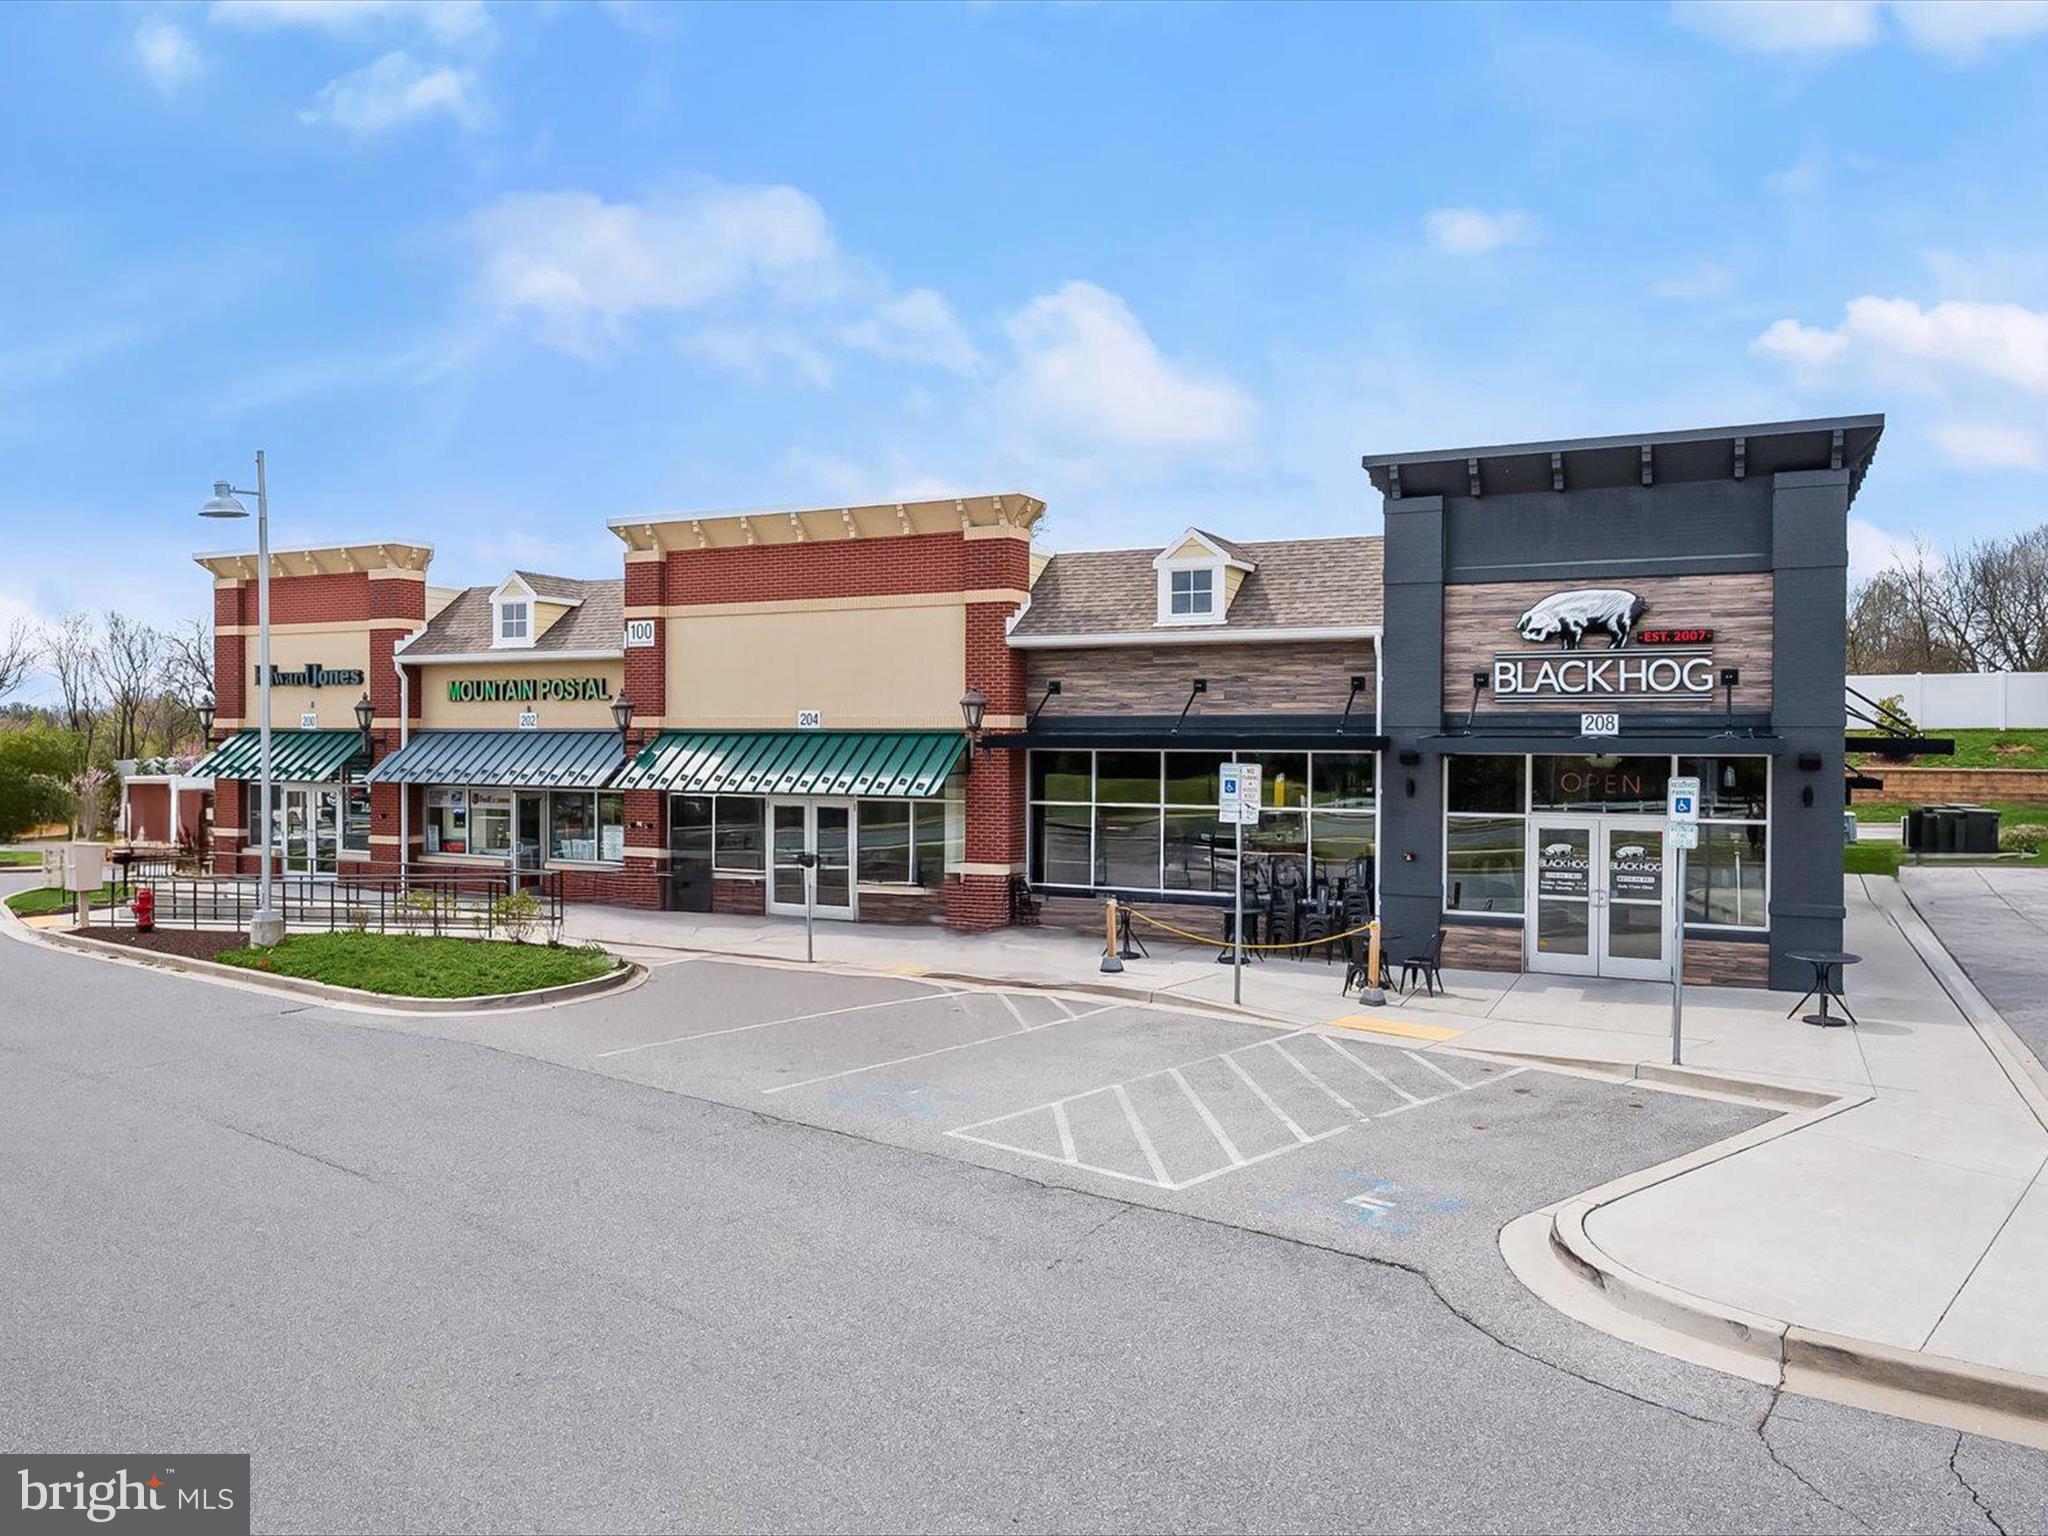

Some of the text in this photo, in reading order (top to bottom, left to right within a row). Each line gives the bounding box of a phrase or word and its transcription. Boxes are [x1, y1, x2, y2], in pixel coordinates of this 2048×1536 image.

[630, 623, 653, 640] 100
[1643, 630, 1706, 642] EST. 2007
[308, 663, 364, 688] Jones
[1494, 658, 1714, 694] BLACK HOG
[448, 677, 613, 702] MOUNTAIN POSTAL
[302, 715, 316, 727] 200
[520, 714, 536, 727] 202
[800, 712, 819, 726] 204
[1584, 714, 1616, 732] 208
[1561, 772, 1641, 795] OPEN
[1539, 858, 1590, 869] BLACK HOG
[1609, 861, 1663, 872] BLACK HOG
